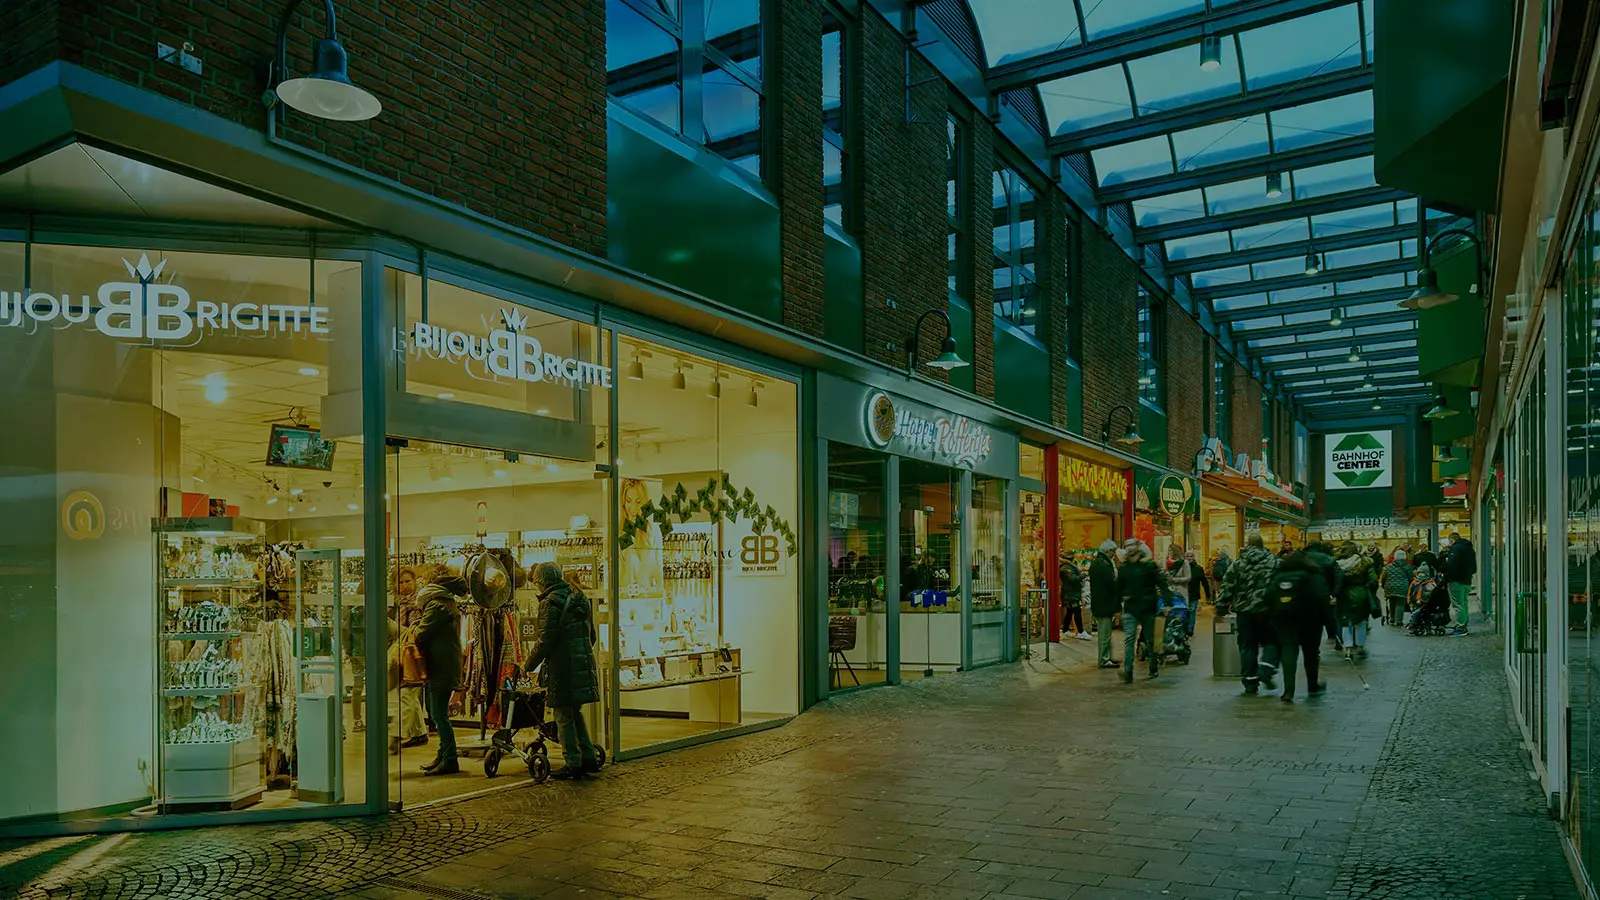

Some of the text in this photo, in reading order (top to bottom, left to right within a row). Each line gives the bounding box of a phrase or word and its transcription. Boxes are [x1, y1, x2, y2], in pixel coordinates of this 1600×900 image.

[414, 321, 489, 361] BIJOU
[895, 409, 936, 446] Happy
[1332, 450, 1385, 462] BAHNHOF
[1336, 460, 1380, 470] CENTER
